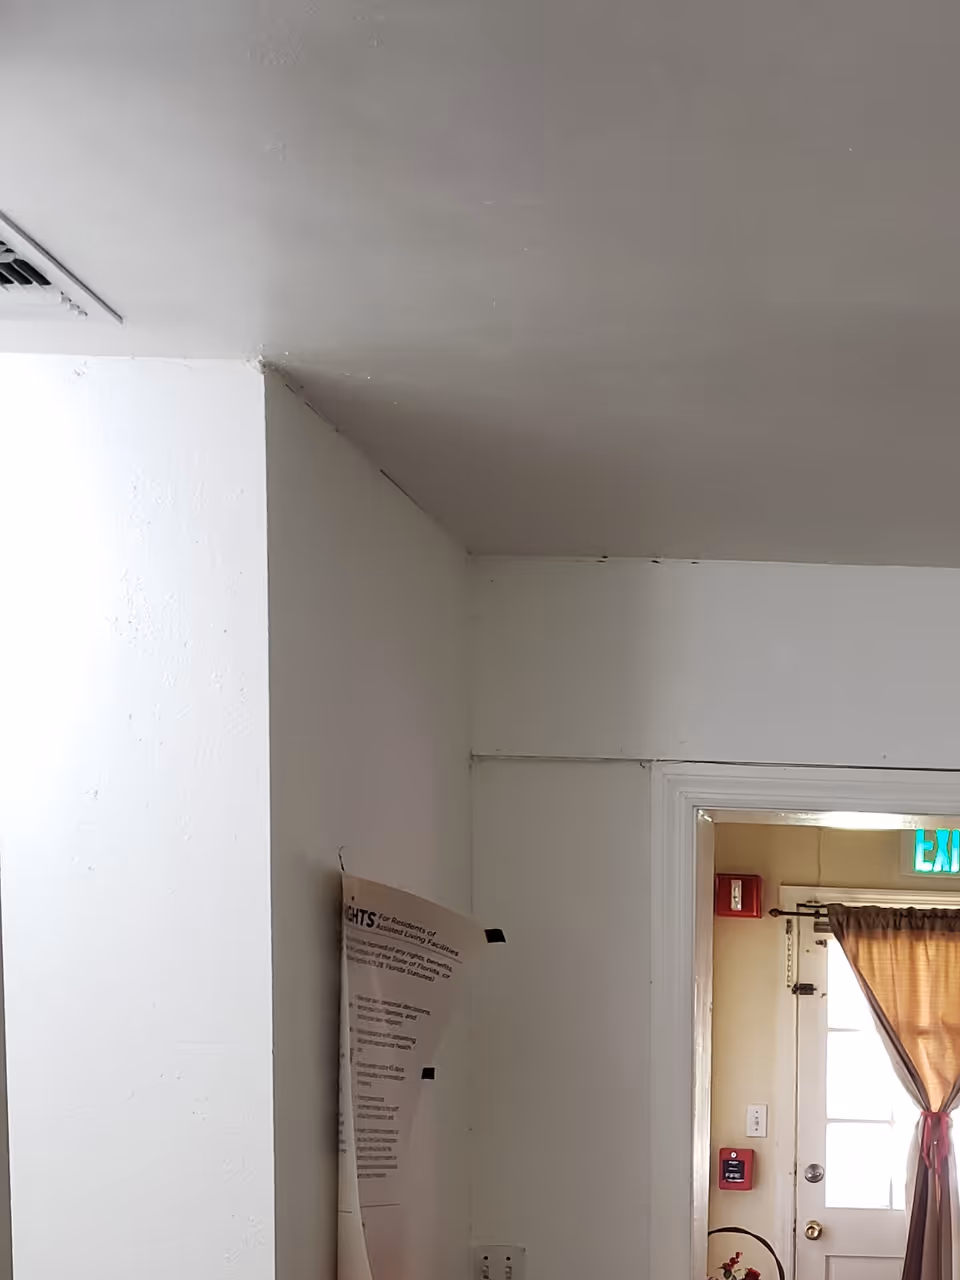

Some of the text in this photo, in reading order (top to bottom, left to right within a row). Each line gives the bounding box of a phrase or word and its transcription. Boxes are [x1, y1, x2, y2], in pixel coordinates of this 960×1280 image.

[392, 917, 425, 934] Residents
[404, 932, 425, 944] Living
[427, 938, 459, 957] Facilities
